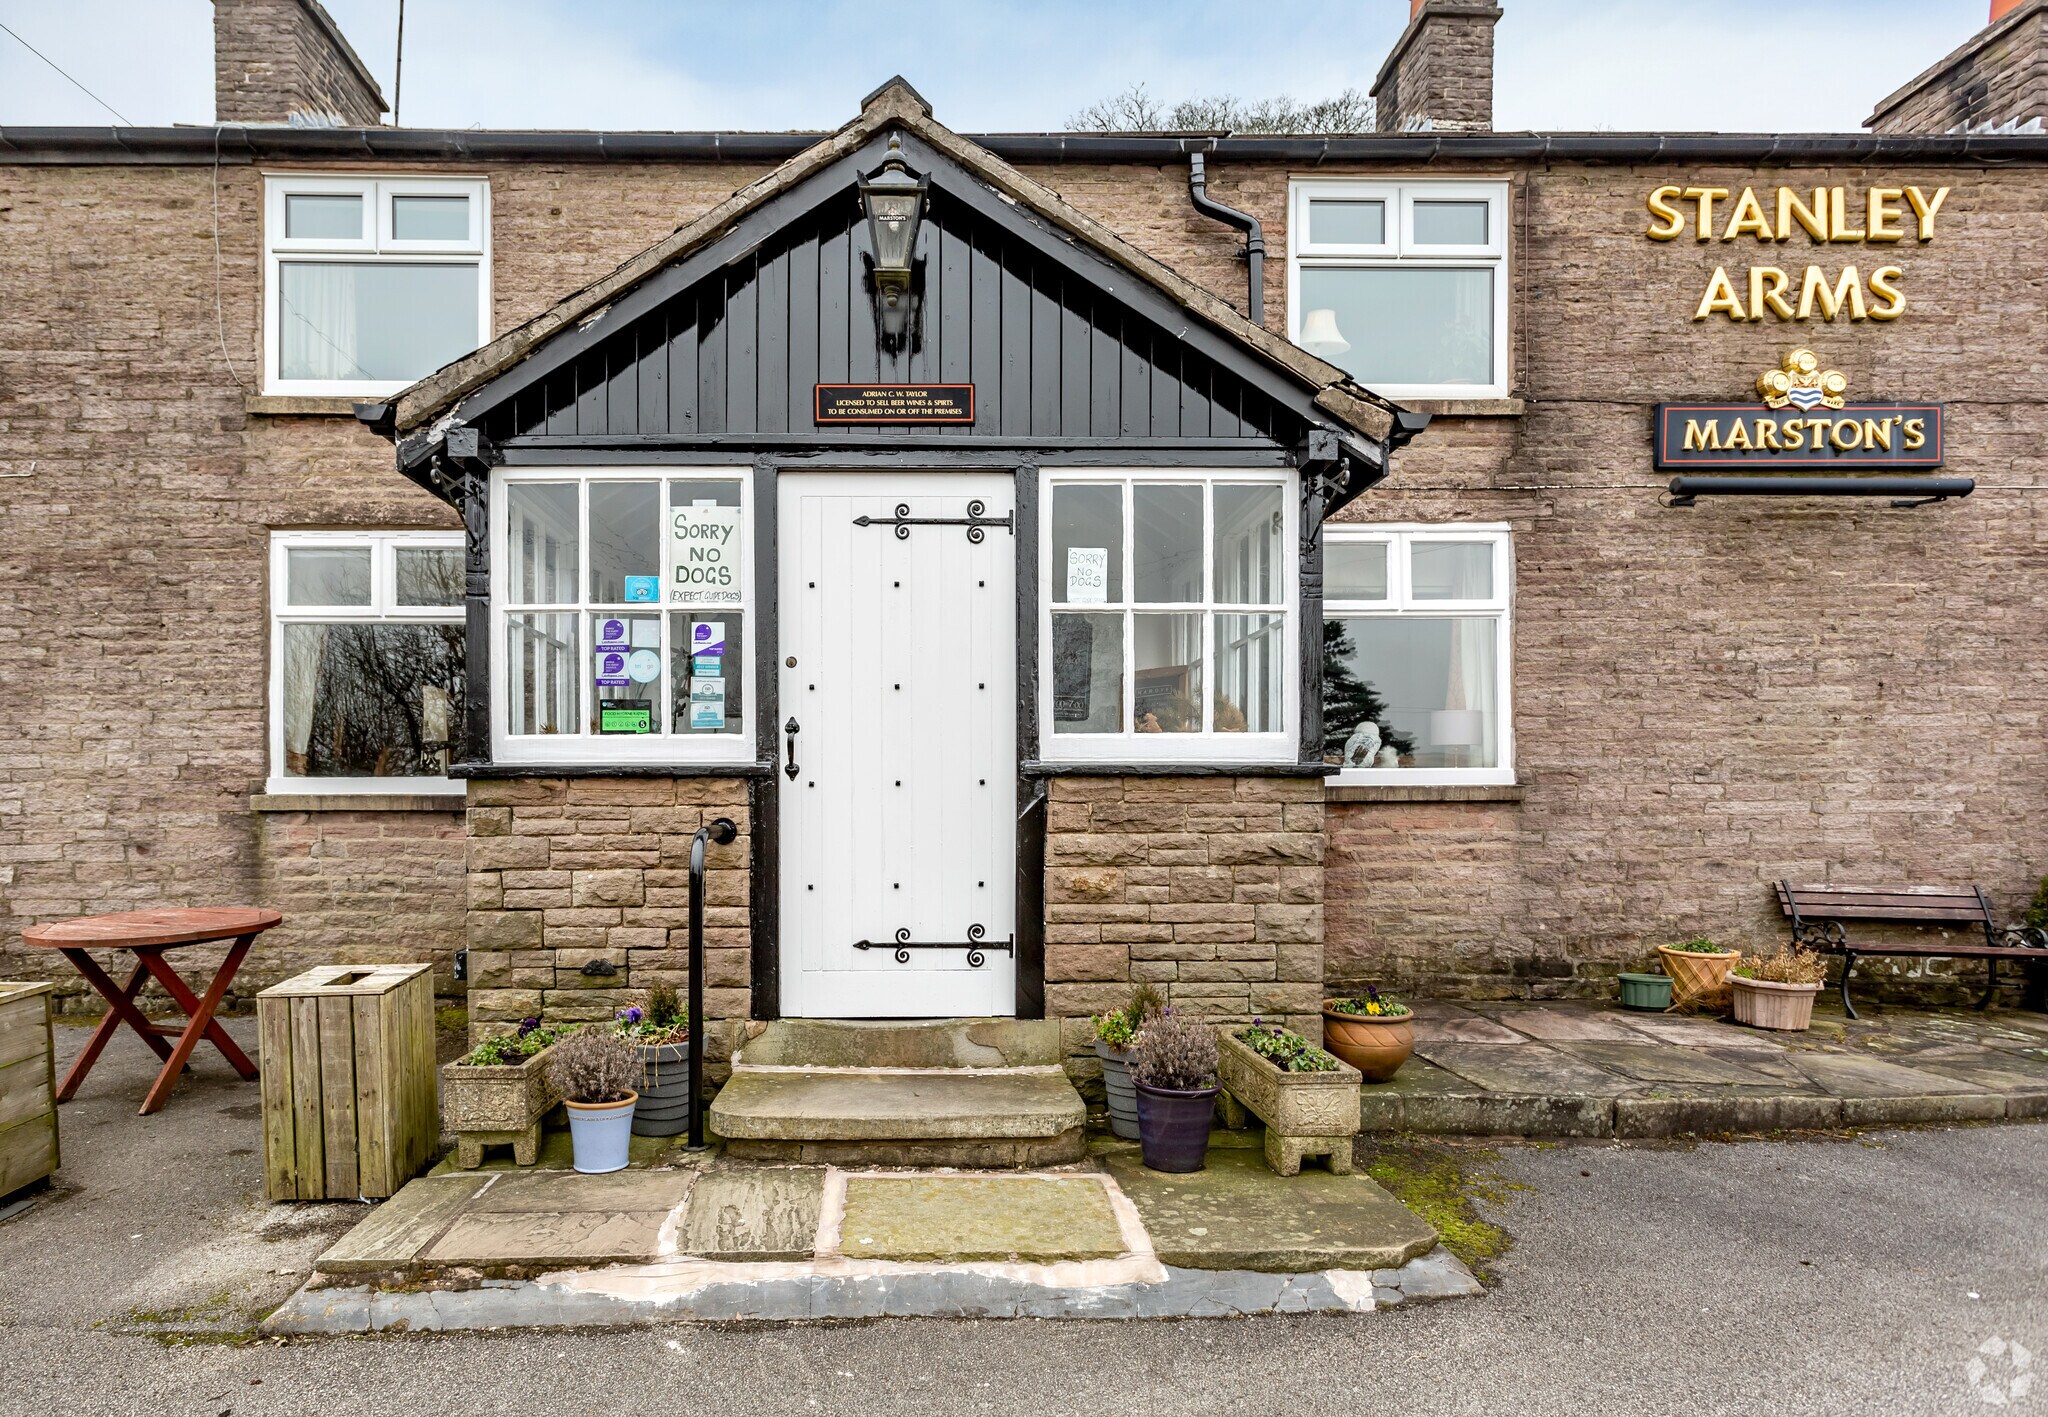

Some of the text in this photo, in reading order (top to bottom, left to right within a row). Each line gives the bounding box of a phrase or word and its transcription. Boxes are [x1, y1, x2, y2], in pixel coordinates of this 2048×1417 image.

[1646, 186, 1951, 243] STANLEY
[1693, 265, 1907, 322] ARMS
[1682, 415, 1926, 452] MARSTON'S
[674, 513, 734, 546] SORRY
[689, 547, 721, 562] NO
[1069, 551, 1106, 568] SORRY
[675, 565, 732, 585] DOGS
[1069, 575, 1102, 587] DOGS
[1077, 567, 1093, 576] NO
